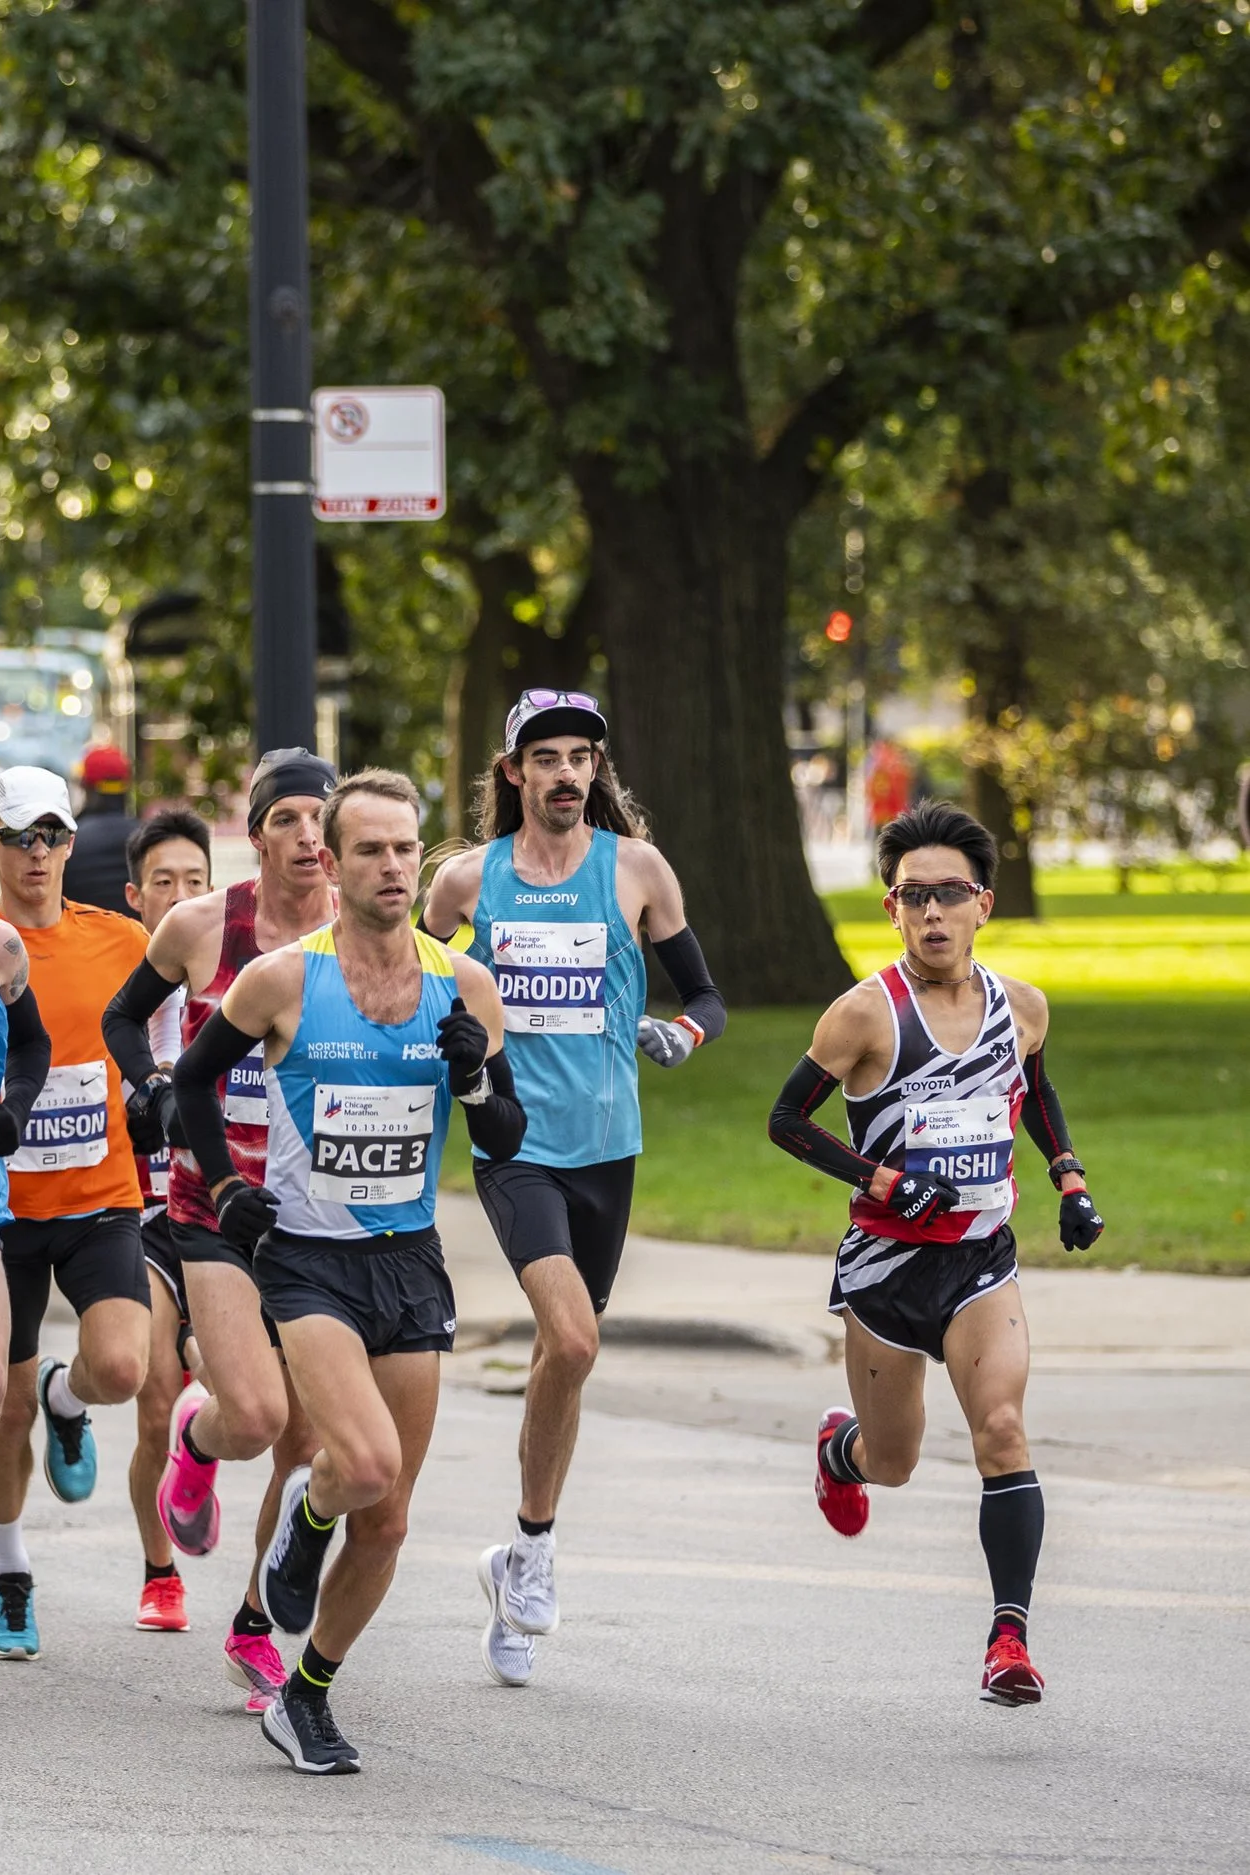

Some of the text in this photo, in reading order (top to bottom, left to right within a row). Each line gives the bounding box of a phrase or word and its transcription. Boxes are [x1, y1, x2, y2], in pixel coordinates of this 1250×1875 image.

[515, 893, 579, 905] saucony
[521, 956, 580, 964] 10.13.2019
[499, 974, 602, 1001] DRODDY
[308, 1042, 364, 1051] NORTHERN
[402, 1043, 443, 1060] HOK
[308, 1050, 379, 1060] ARIZONA ELITE
[230, 1068, 266, 1086] BUM
[905, 1080, 952, 1092] TOYOTA
[36, 1096, 86, 1107] 0.13.2019
[345, 1101, 373, 1110] Chicago
[25, 1111, 105, 1140] TINSON
[929, 1116, 953, 1124] Chicago
[345, 1124, 409, 1132] 10.13.2019
[937, 1133, 994, 1144] 10.13.2019
[318, 1139, 425, 1172] PACE 3
[928, 1152, 997, 1181] OISHI
[902, 1186, 937, 1219] TOYOTA
